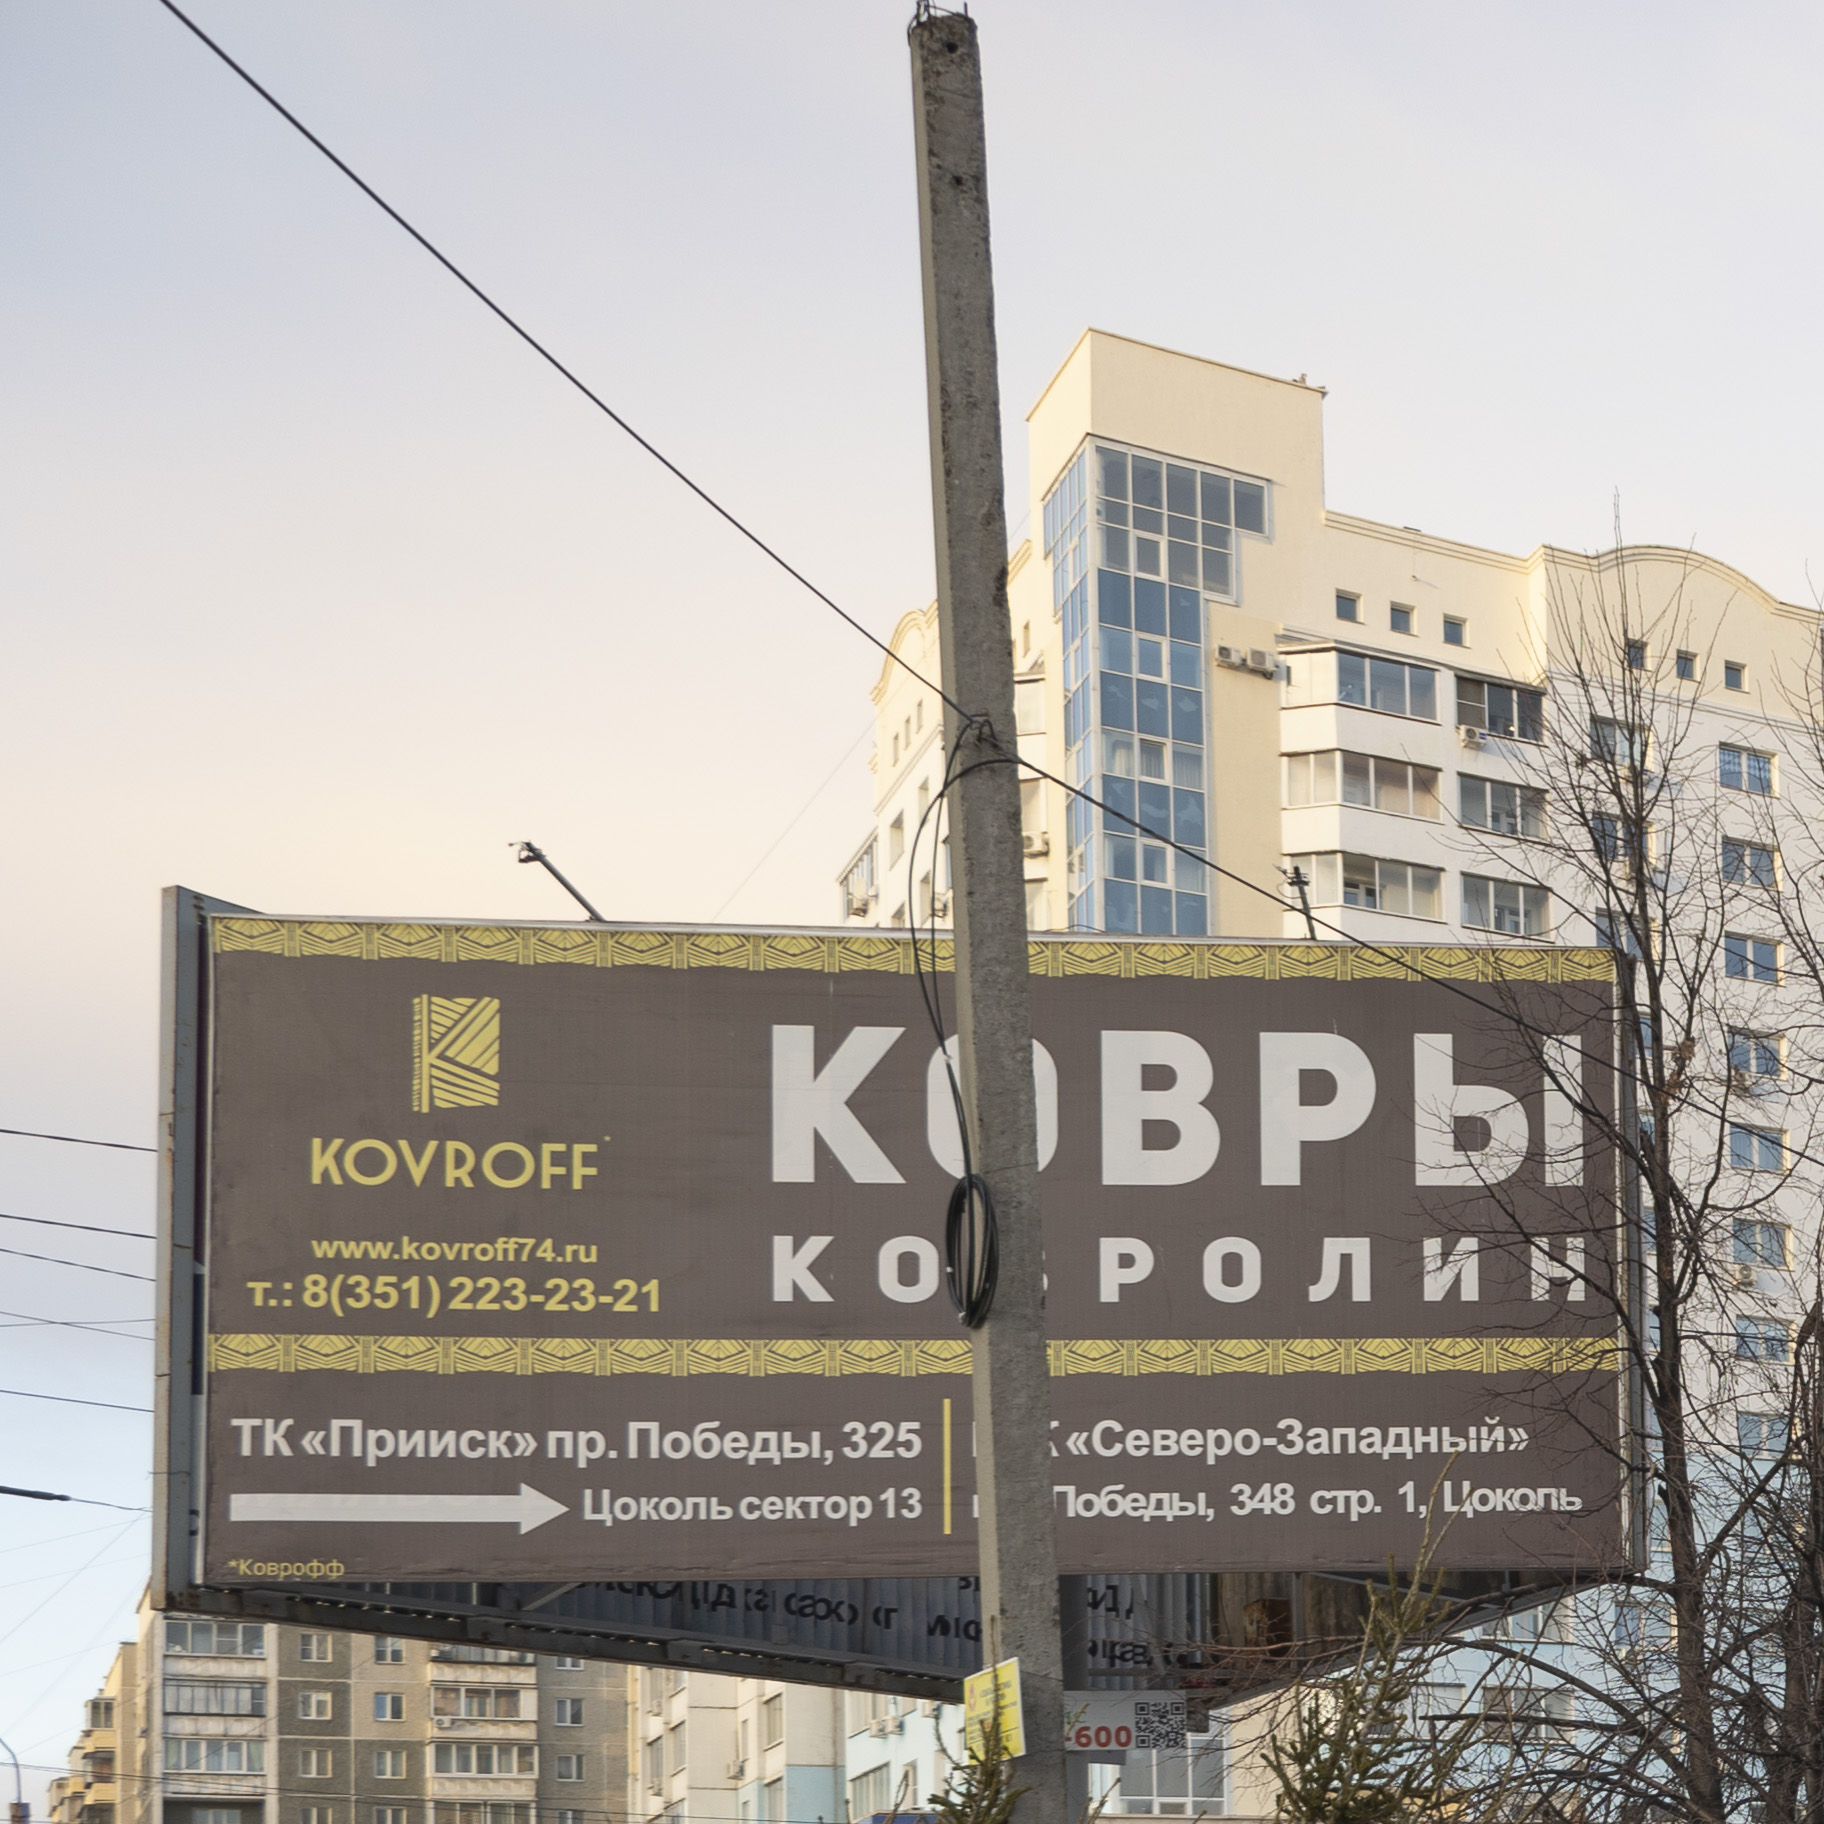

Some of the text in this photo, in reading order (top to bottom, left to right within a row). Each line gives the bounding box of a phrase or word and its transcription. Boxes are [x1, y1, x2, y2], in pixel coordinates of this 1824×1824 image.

[771, 1023, 1585, 1187] КОВРЫ
[311, 1235, 598, 1264] www.kovroff74.ru
[772, 1234, 1586, 1304] КОРОЛИН
[447, 1276, 661, 1313] 223-23-21
[230, 1417, 295, 1458] ТК
[300, 1417, 538, 1467] «Прииск»
[547, 1430, 618, 1469] пр.
[627, 1420, 834, 1467] Победы,
[841, 1420, 923, 1460] 325
[1065, 1417, 1529, 1466] «Северо-Западный»
[583, 1486, 924, 1528] Цоколь сектор 13
[1052, 1478, 1583, 1524] Победы, 348 стр. 1, Цоколь
